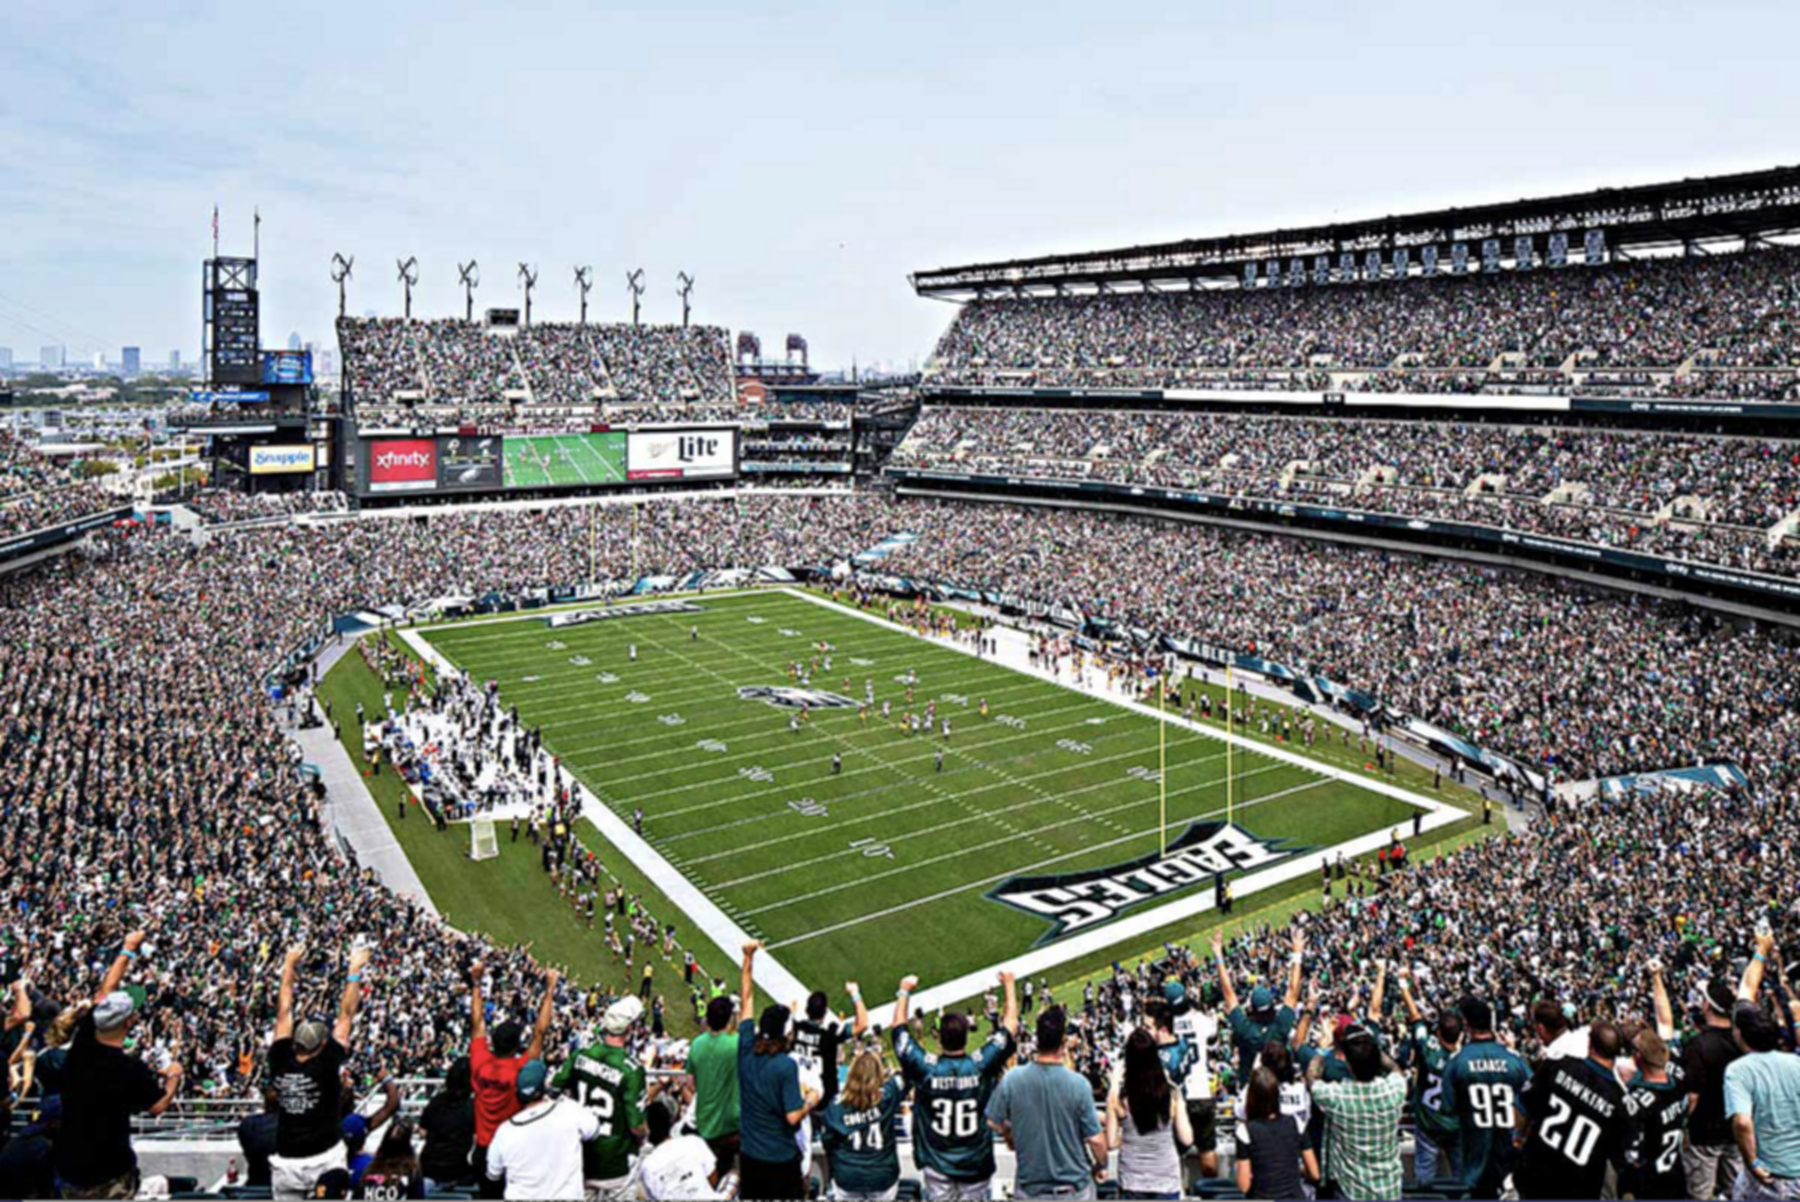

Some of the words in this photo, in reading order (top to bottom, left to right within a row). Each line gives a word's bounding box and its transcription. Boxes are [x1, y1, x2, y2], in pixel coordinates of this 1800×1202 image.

[254, 450, 311, 466] Snapple
[376, 451, 431, 470] xfinity
[677, 436, 718, 462] Lite
[995, 824, 1293, 934] EAGLES
[1468, 1082, 1516, 1128] 93
[1554, 1069, 1616, 1119] DAWKINS
[931, 1098, 978, 1136] 36
[1538, 1092, 1602, 1166] 20
